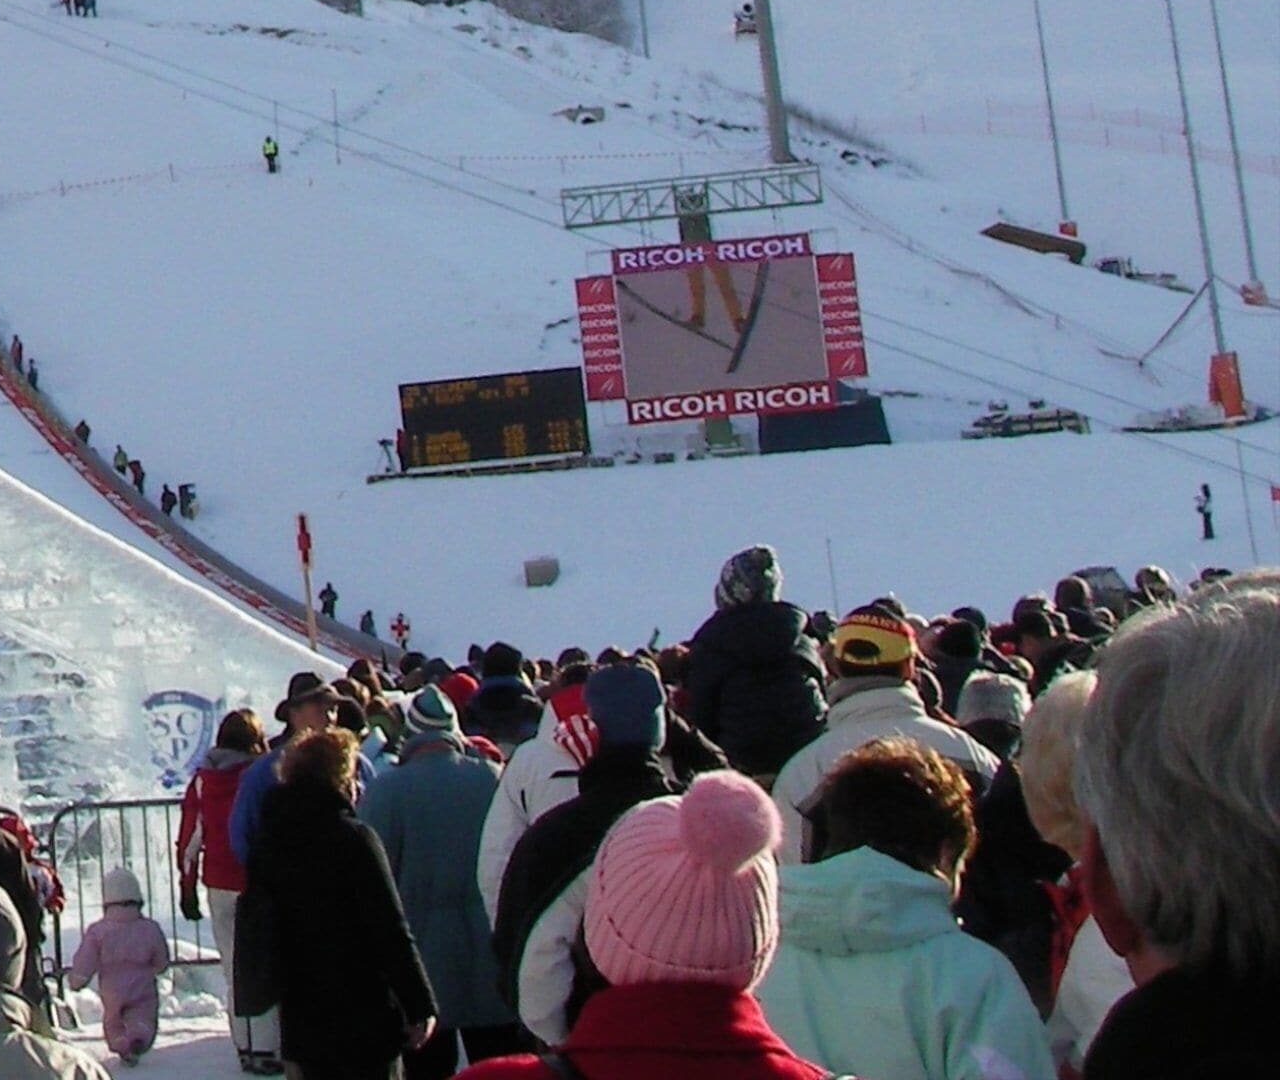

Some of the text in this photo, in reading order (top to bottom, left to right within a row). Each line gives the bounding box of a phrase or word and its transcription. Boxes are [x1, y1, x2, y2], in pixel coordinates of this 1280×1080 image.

[619, 237, 804, 269] RICOH RICOH
[631, 386, 830, 421] RICOH RICOH
